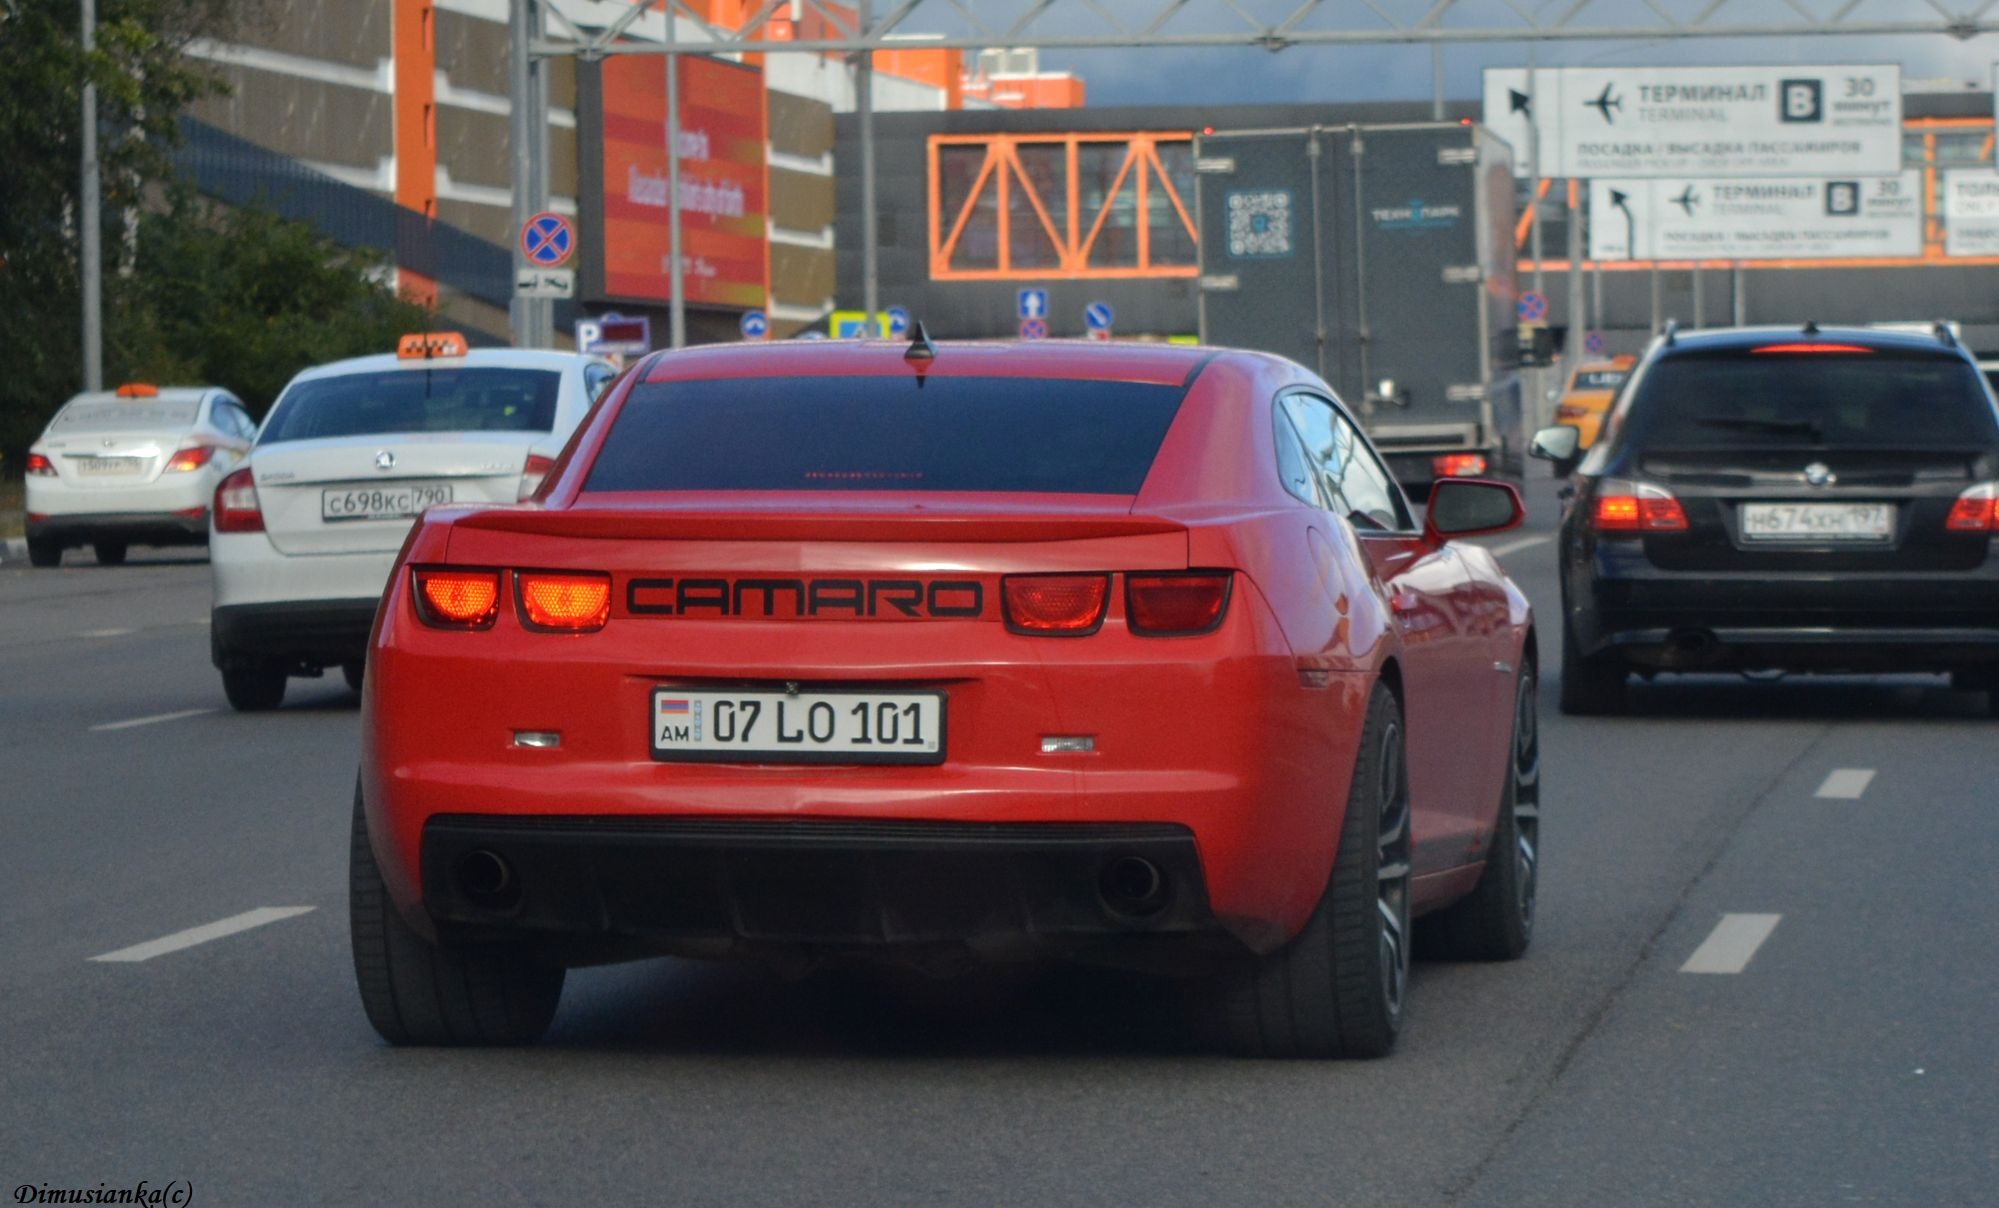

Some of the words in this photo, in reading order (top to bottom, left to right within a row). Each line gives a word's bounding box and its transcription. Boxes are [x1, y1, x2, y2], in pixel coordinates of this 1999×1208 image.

[1638, 85, 1766, 102] ТЕРМИНАЛ
[1844, 78, 1875, 97] 30
[1787, 85, 1815, 118] B
[1713, 185, 1814, 200] ТЕРМИНАЛ
[1878, 181, 1900, 196] 30
[580, 322, 600, 352] P
[330, 490, 411, 514] С698КС
[415, 486, 445, 506] 790
[626, 578, 983, 617] CAMARO
[660, 725, 690, 742] AM
[713, 700, 761, 742] 07
[777, 701, 835, 744] LO
[851, 702, 924, 745] 101
